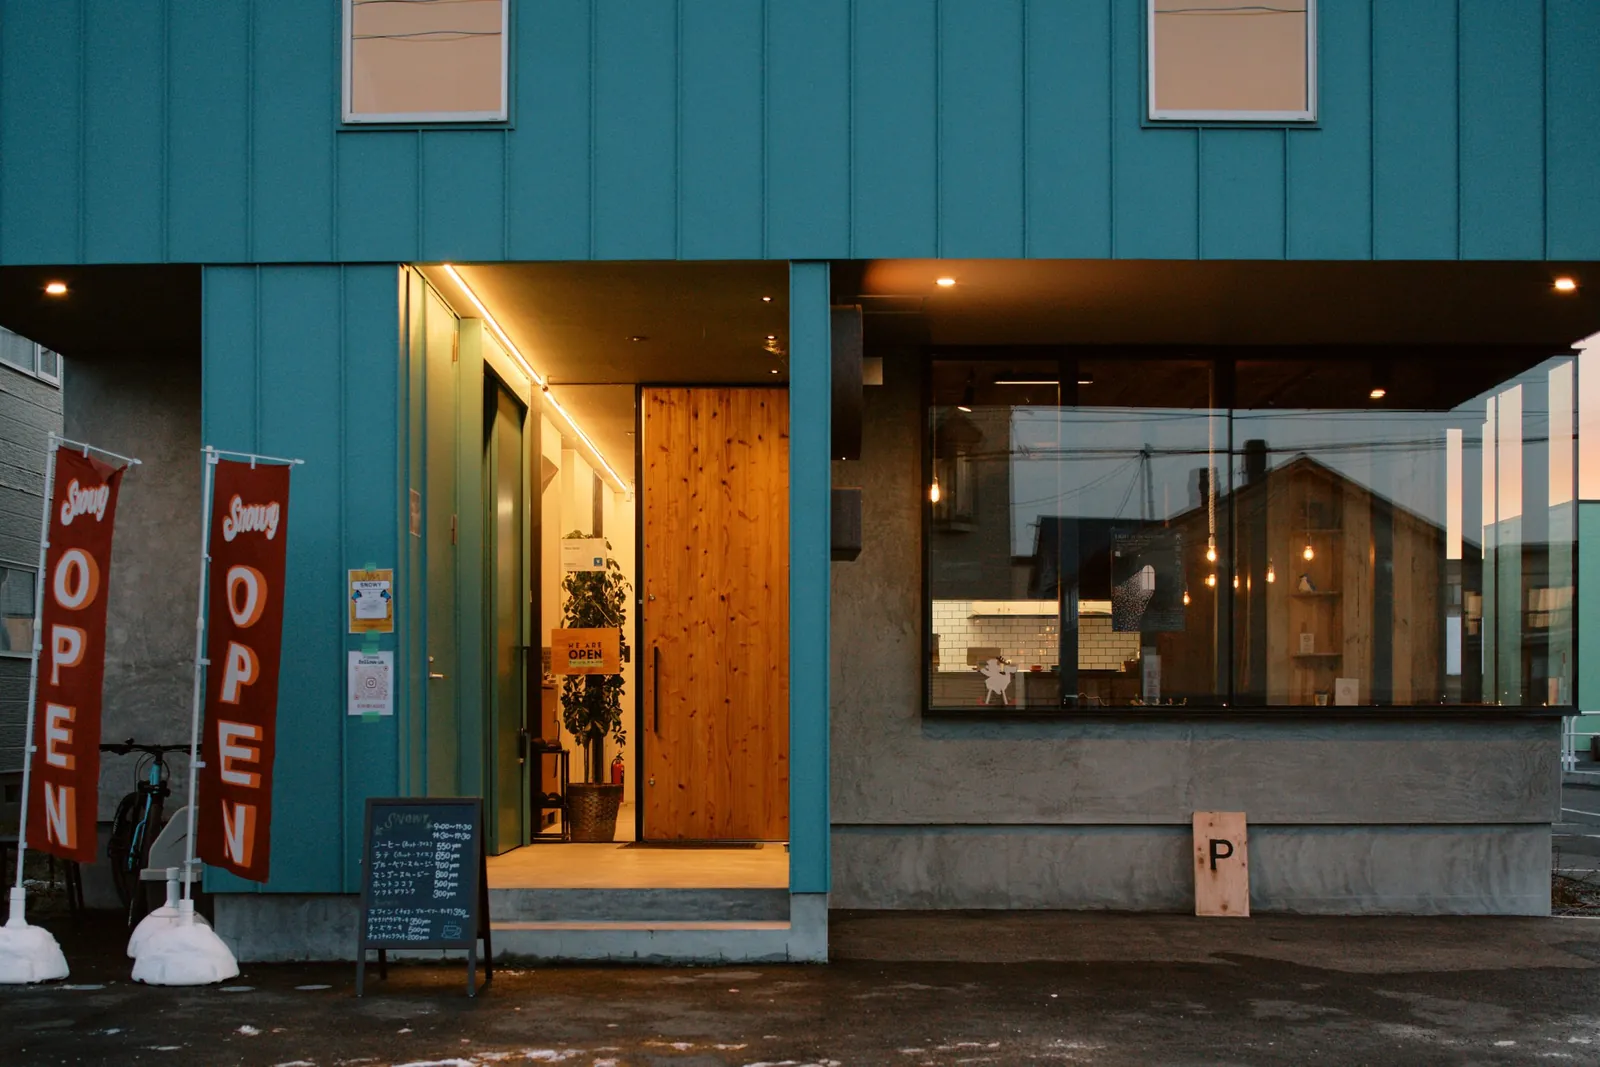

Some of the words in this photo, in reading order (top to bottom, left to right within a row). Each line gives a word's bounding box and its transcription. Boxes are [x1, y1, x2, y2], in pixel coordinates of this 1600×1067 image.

[223, 494, 280, 542] Snowy
[569, 649, 602, 660] OPEN
[45, 548, 100, 850] OPEN
[217, 564, 268, 868] OPEN
[1209, 838, 1234, 871] P
